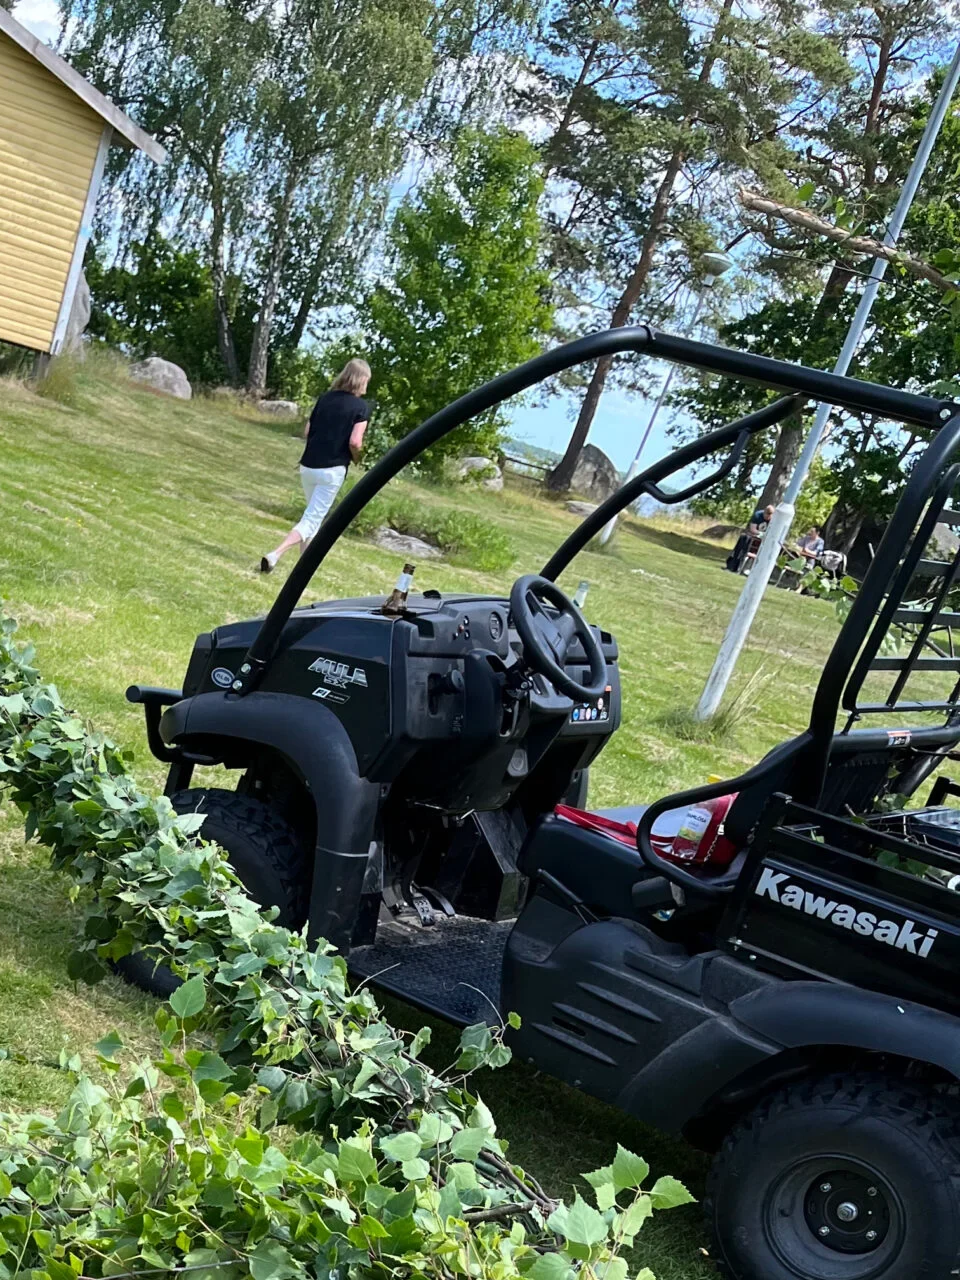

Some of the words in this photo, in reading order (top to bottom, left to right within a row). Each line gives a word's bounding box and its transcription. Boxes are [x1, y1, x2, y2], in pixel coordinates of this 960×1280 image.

[307, 656, 369, 688] MULE
[323, 674, 347, 690] SX
[754, 867, 939, 959] Kawasaki
